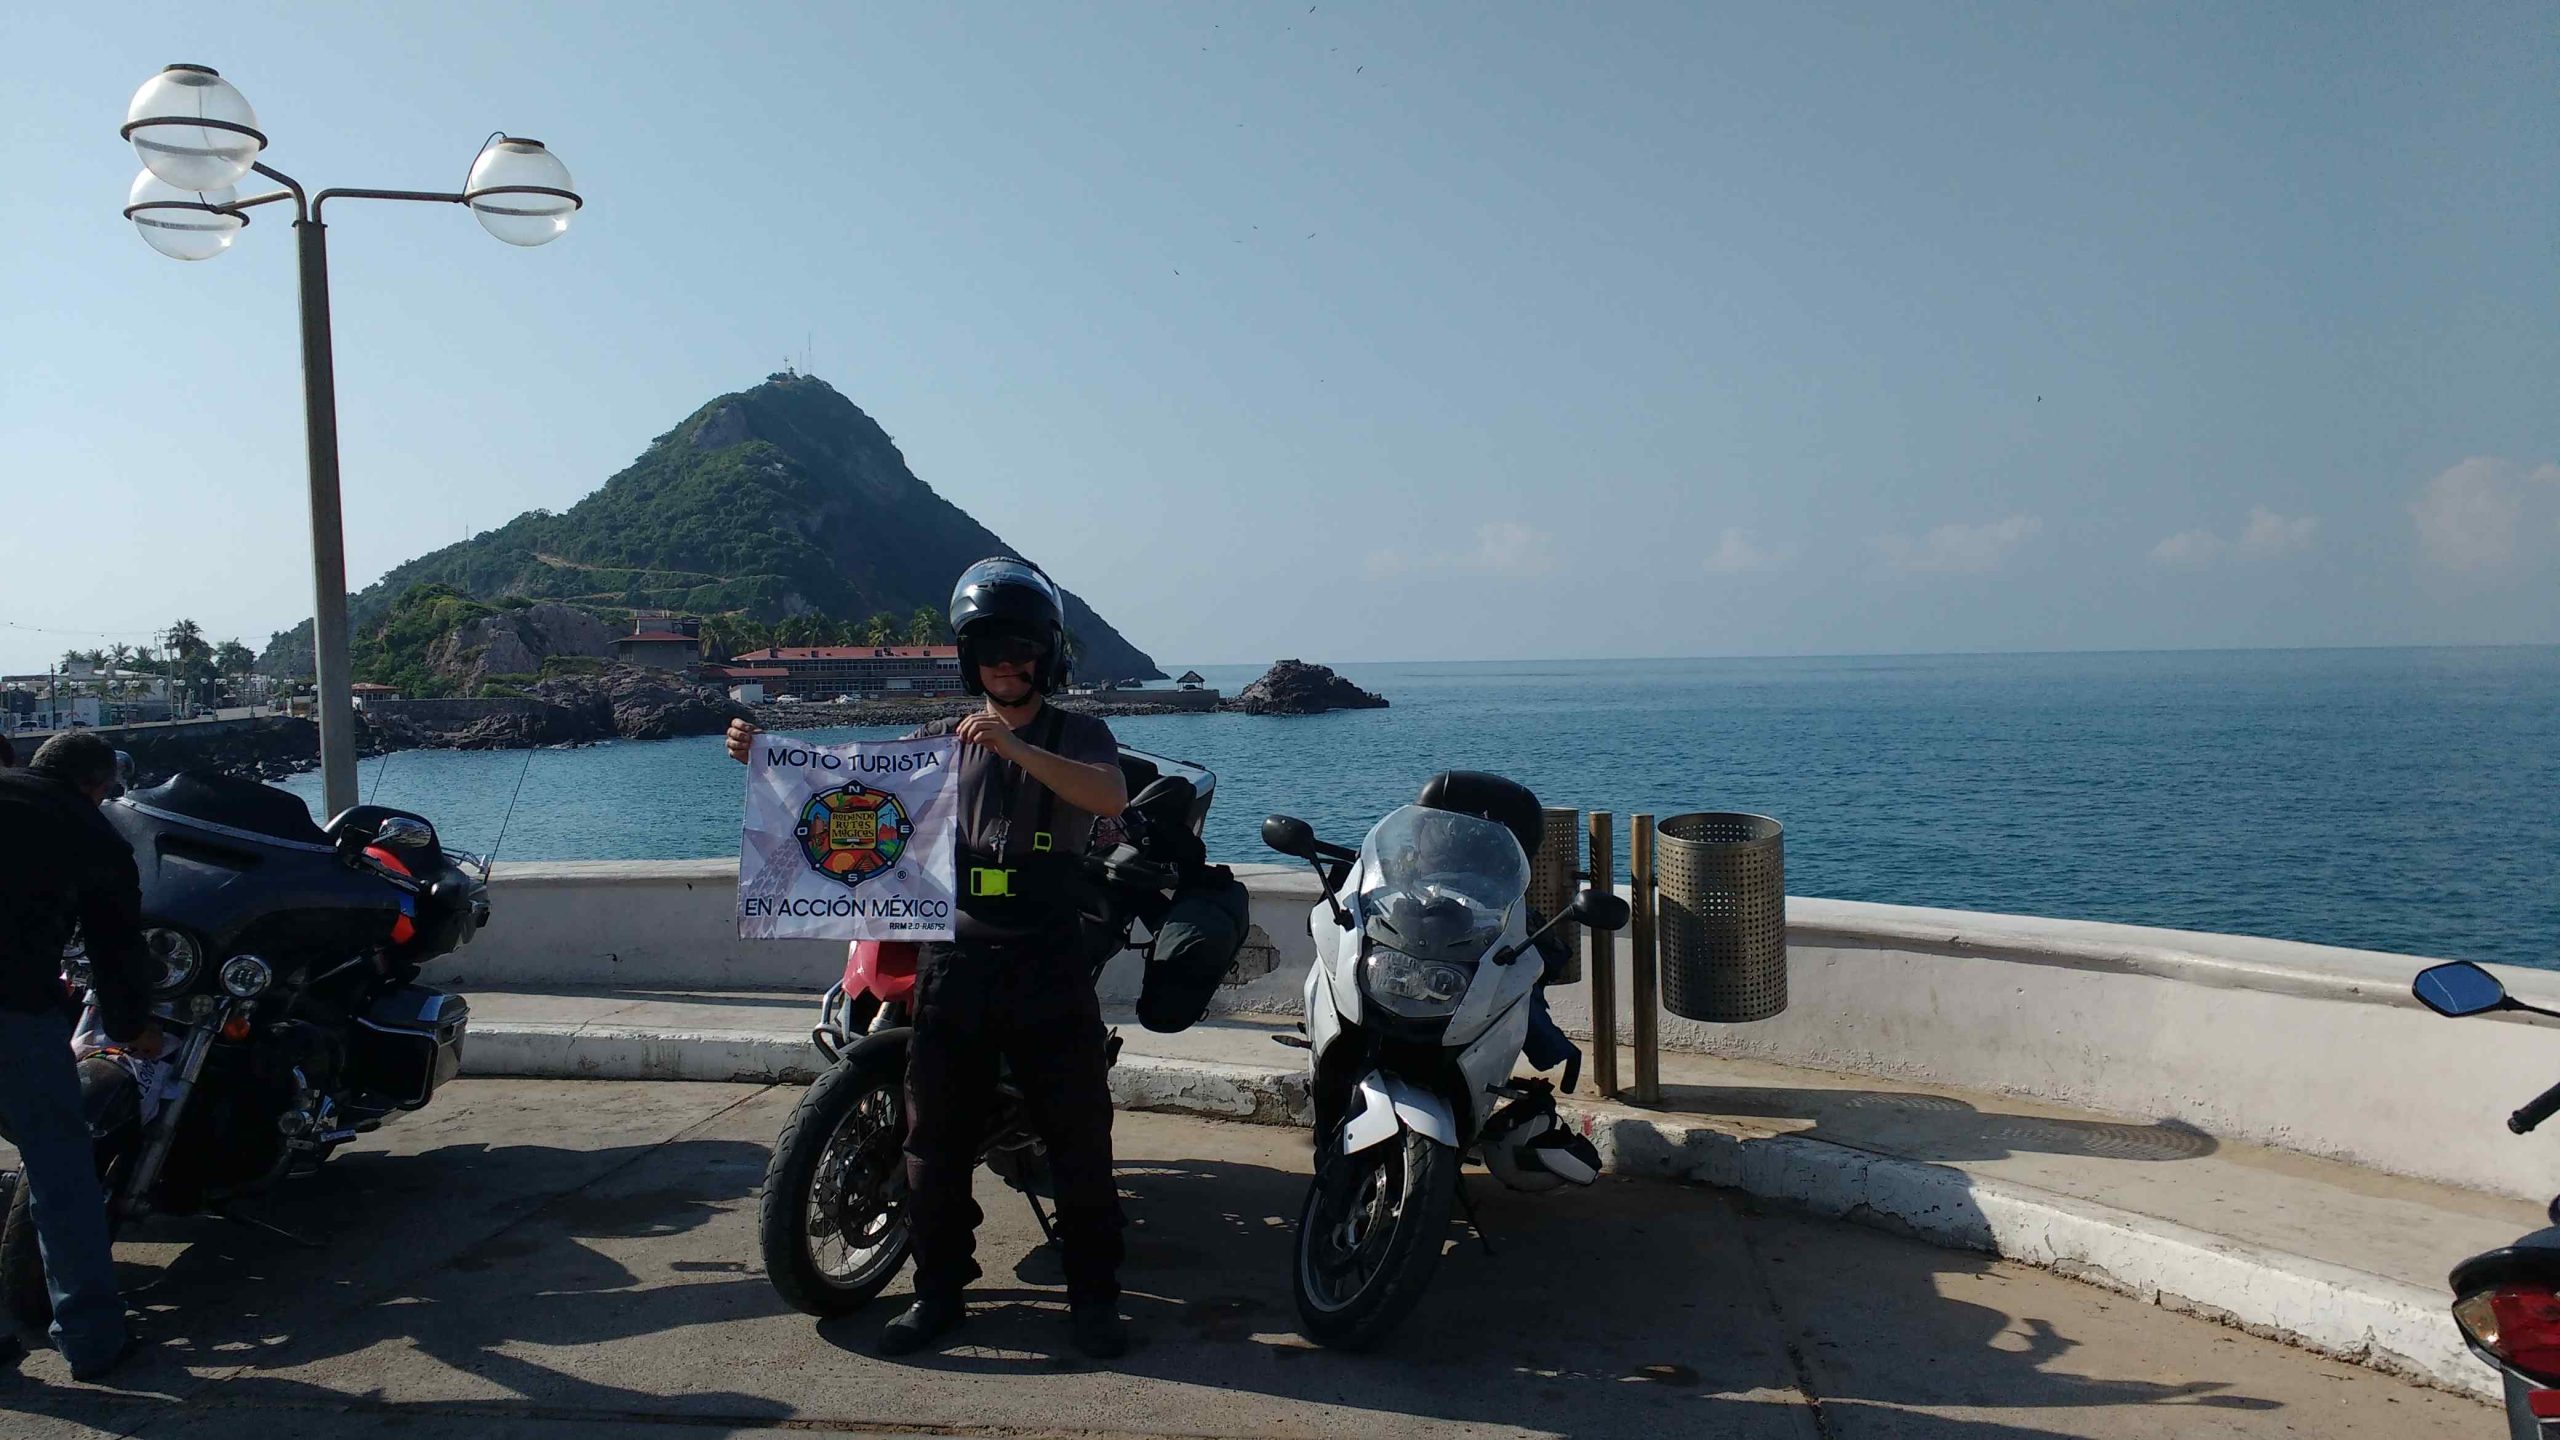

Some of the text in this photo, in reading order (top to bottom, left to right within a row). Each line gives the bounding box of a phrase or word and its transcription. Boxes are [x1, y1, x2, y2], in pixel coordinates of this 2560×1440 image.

[767, 748, 939, 773] MOTO TURISTA
[848, 785, 861, 793] N
[900, 825, 910, 833] E
[847, 873, 858, 882] S
[745, 895, 949, 918] EN ACCIÓN MÉXICO
[889, 922, 907, 930] RRM
